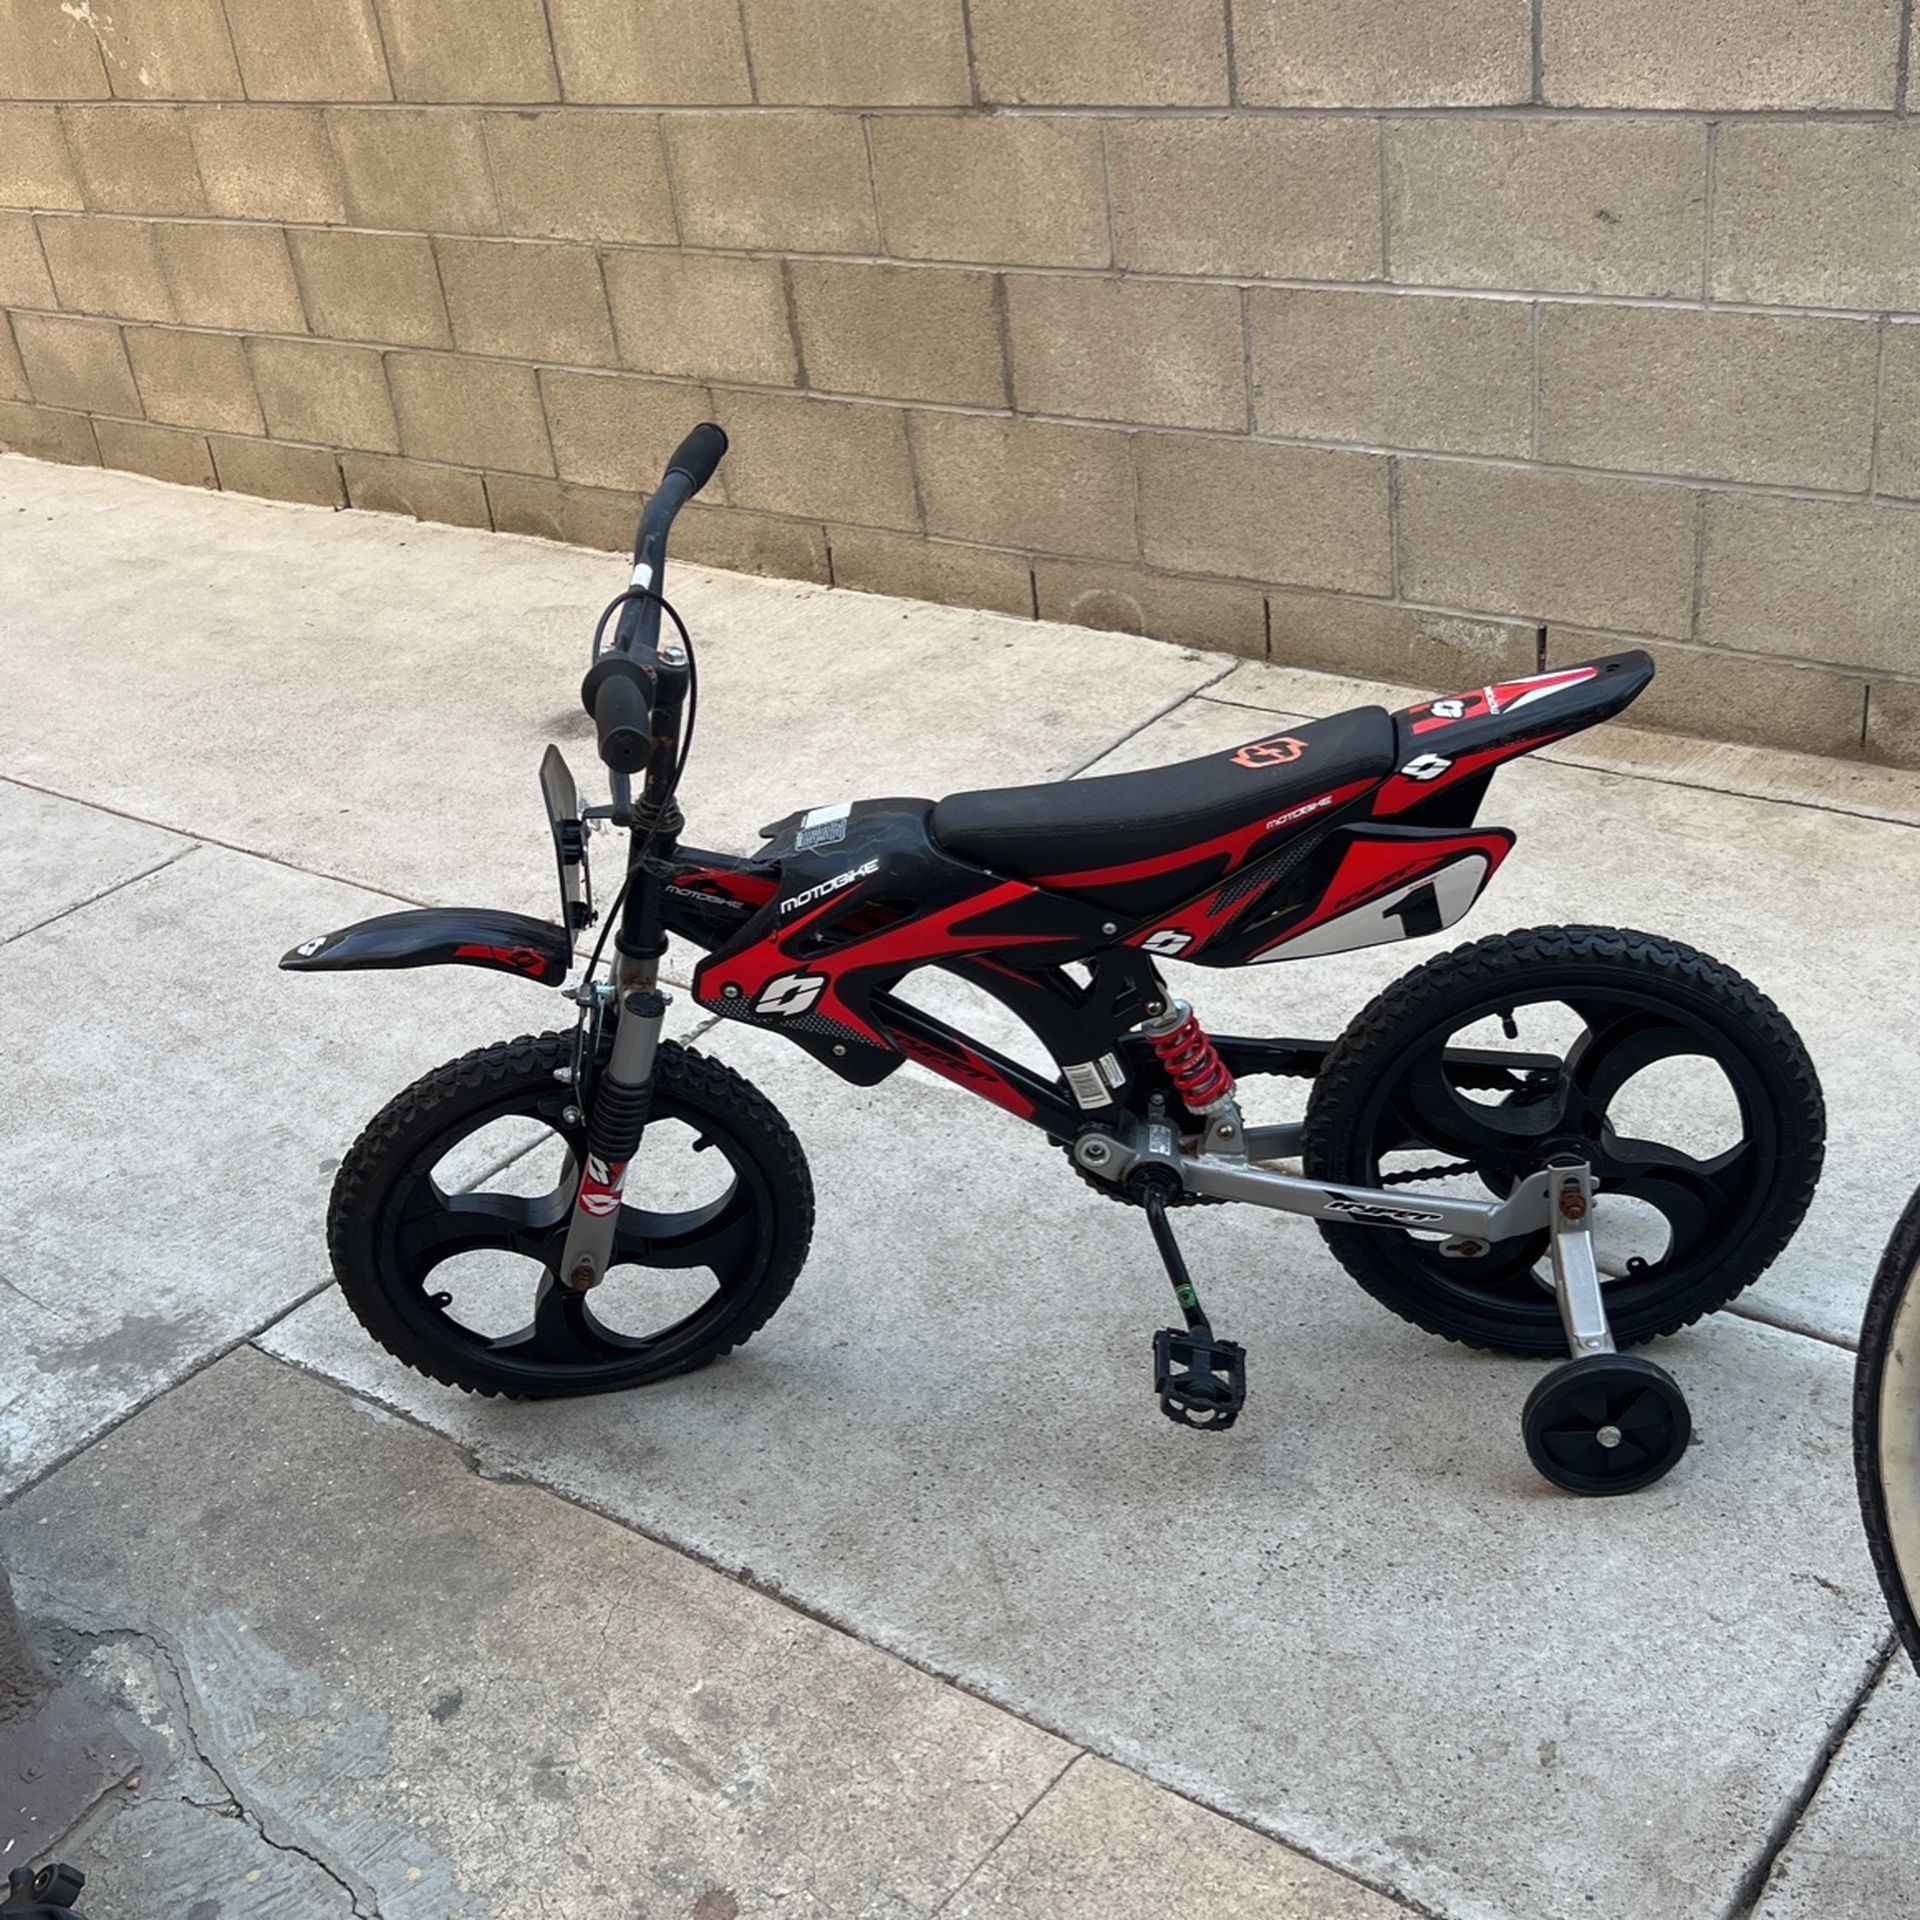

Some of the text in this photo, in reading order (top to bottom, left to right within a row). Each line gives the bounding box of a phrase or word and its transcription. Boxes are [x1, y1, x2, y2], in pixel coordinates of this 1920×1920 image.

[1266, 795, 1332, 829] MOTOBIKE
[664, 884, 744, 909] MOTOBIKE
[780, 859, 879, 914] MOTOBIKE
[1382, 881, 1443, 937] 1
